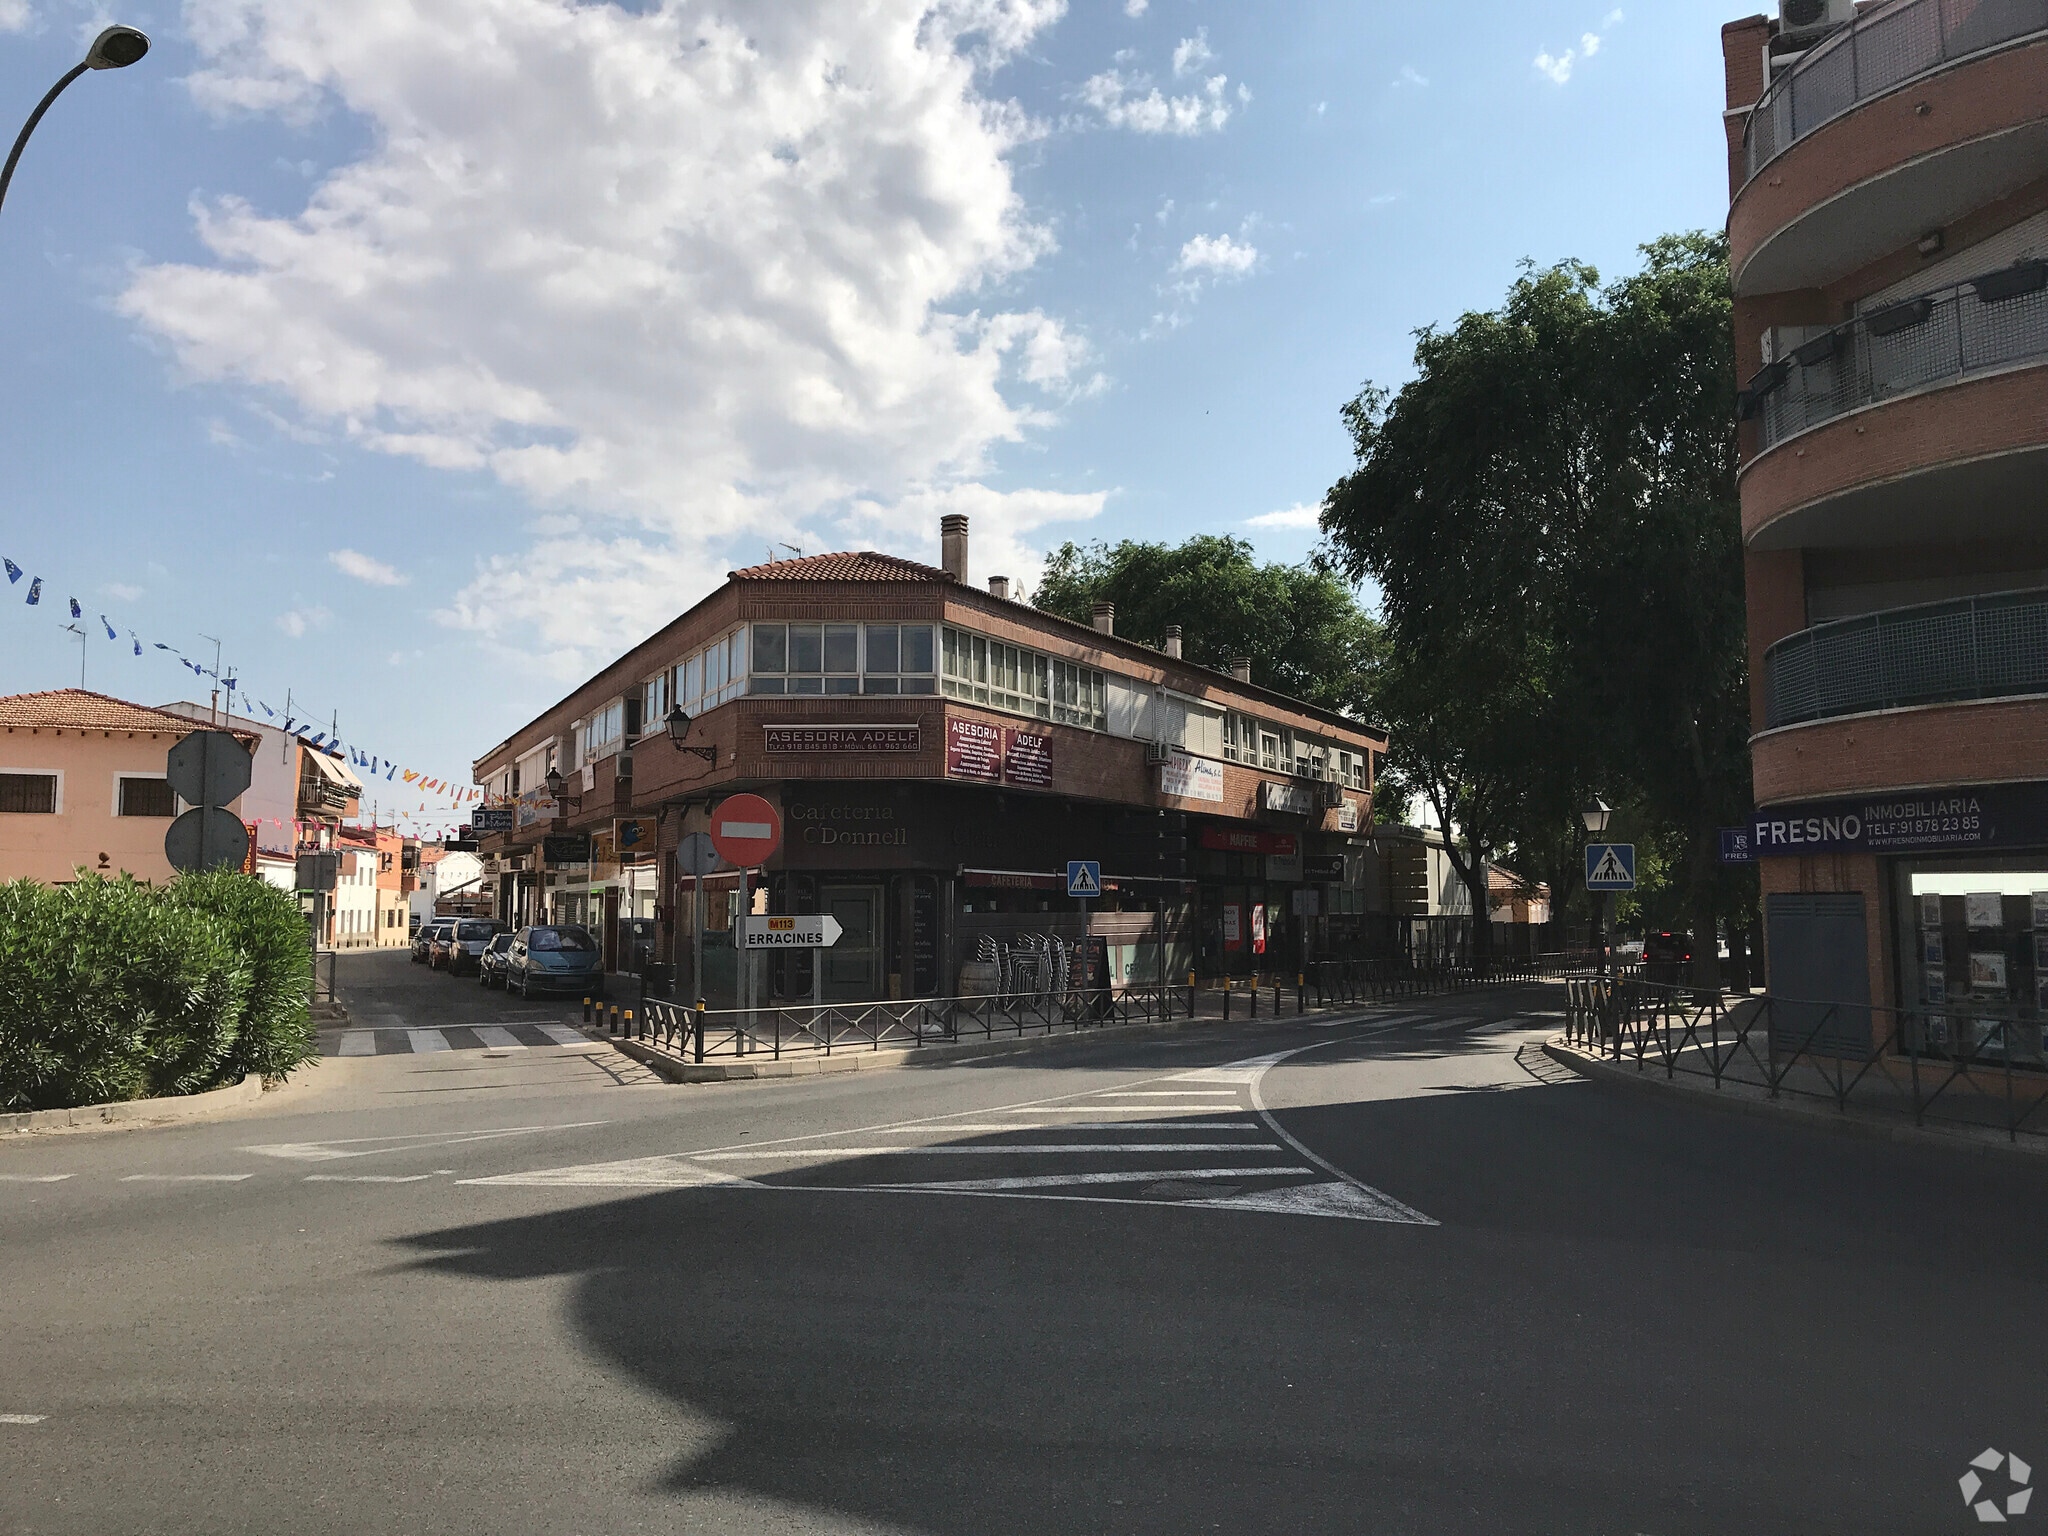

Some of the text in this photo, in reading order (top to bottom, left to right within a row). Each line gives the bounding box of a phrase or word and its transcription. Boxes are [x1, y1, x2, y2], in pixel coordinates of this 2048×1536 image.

[768, 731, 918, 742] ASESORIA ADELF
[951, 721, 998, 741] ASESORIA
[1016, 734, 1043, 748] ADELF
[1864, 797, 1981, 821] INMOBILIARIA
[1755, 814, 1861, 846] FRESNO
[1915, 818, 1940, 833] 878
[1942, 817, 1960, 831] 23
[1962, 816, 1980, 830] 85
[991, 874, 1033, 887] CAFETERIA
[769, 919, 794, 929] M113
[745, 932, 823, 945] ERRACINES
